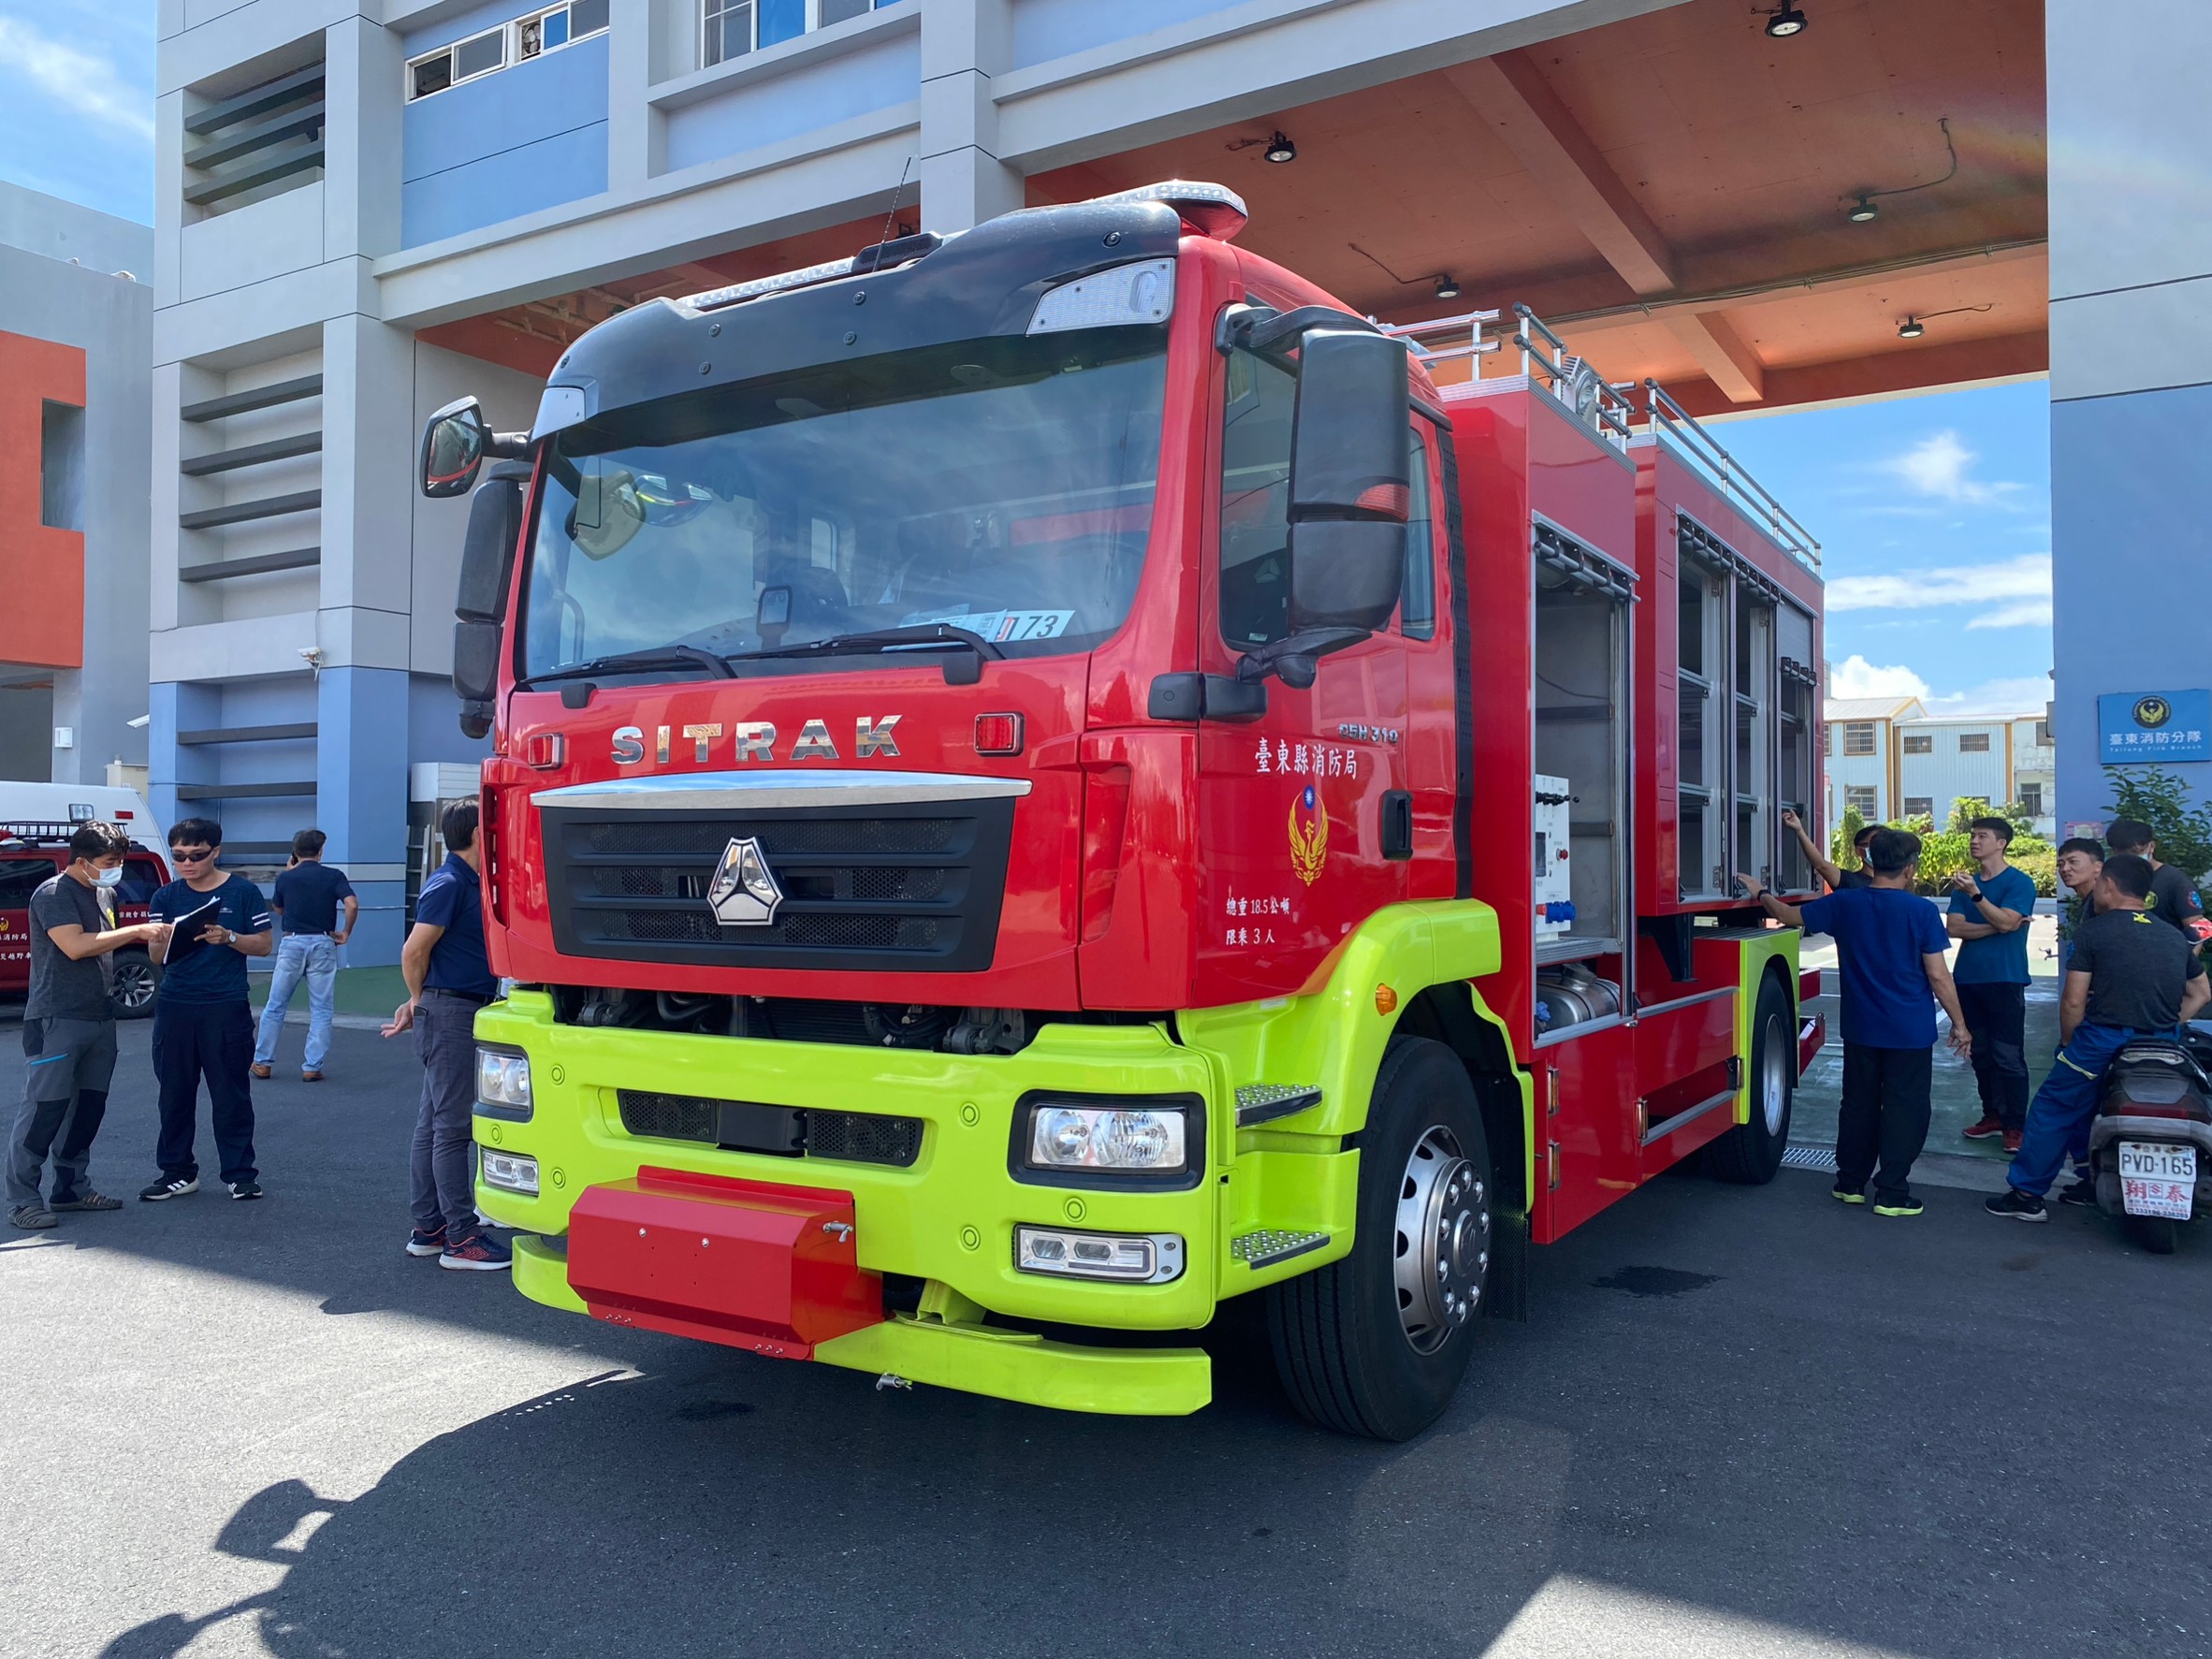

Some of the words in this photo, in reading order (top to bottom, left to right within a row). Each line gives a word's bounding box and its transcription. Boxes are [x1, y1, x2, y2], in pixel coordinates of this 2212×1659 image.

[610, 714, 904, 765] SITRAK
[1370, 725, 1399, 744] 310
[2108, 730, 2202, 746] 臺東消防分隊
[1255, 735, 1358, 780] 臺東縣消防局
[0, 932, 28, 941] 消防局
